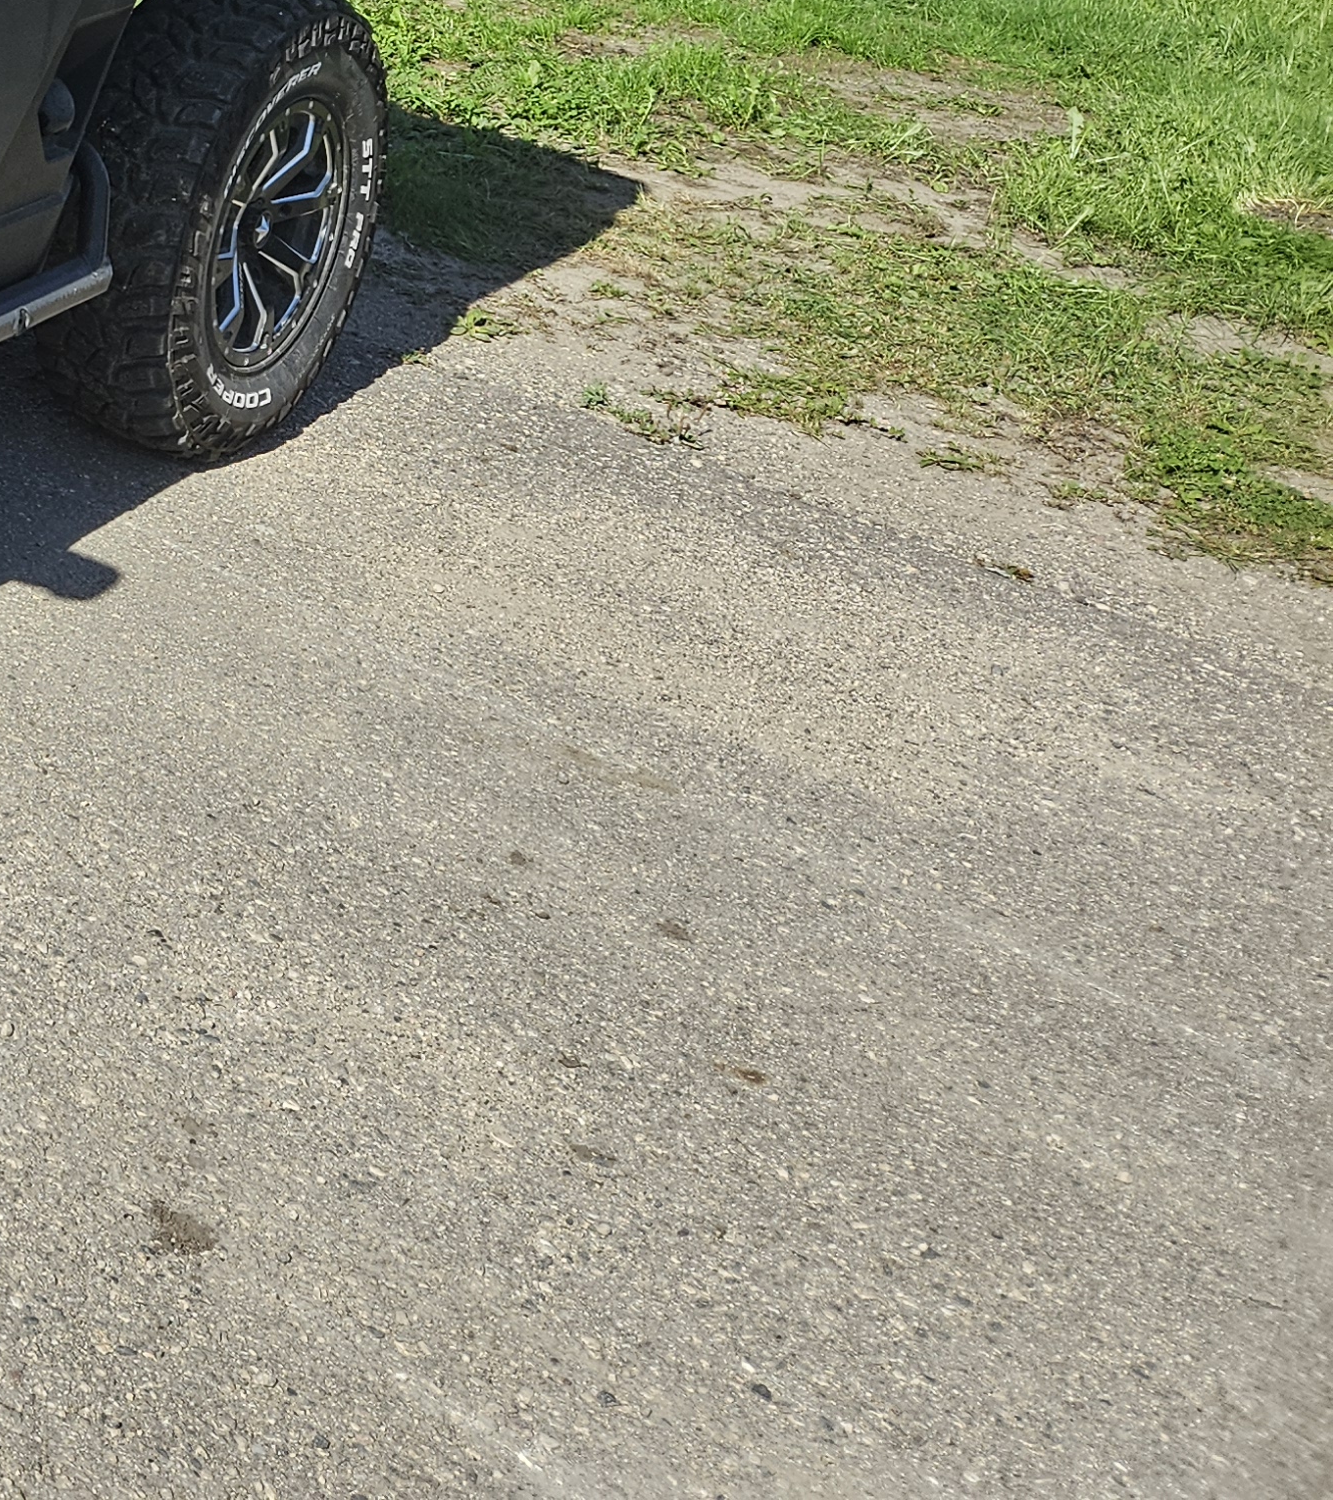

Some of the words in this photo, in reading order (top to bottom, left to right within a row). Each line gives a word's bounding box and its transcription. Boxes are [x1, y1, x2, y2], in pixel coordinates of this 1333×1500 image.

[359, 137, 373, 201] STT
[344, 211, 364, 269] PRO
[206, 363, 272, 409] COOPER
